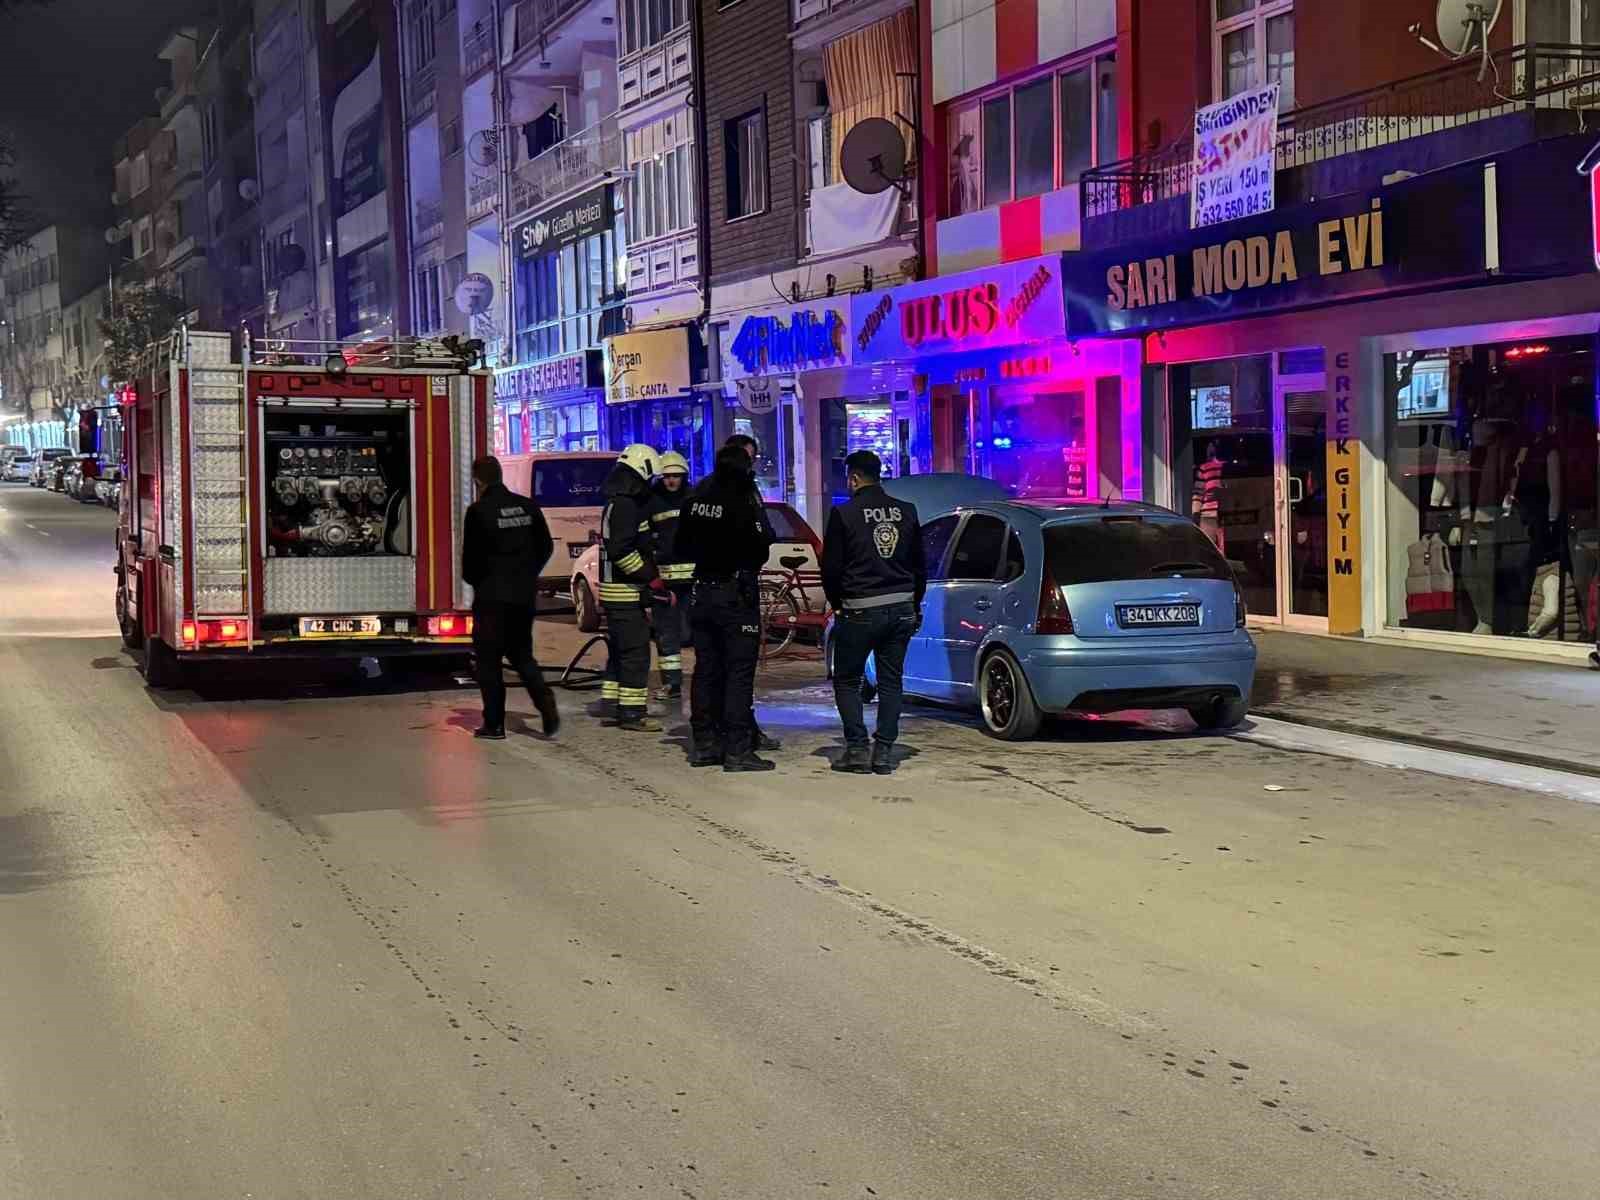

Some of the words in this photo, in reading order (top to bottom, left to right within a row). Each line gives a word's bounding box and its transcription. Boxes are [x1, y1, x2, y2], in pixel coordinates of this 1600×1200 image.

[1203, 202, 1222, 225] 532
[1225, 197, 1244, 219] 550
[1246, 192, 1260, 214] 84
[1106, 254, 1177, 313] SARI
[1192, 230, 1298, 297] MODA
[1318, 197, 1384, 276] EVİ
[898, 282, 999, 348] ULUS
[640, 383, 669, 399] ÇANTA
[1335, 352, 1350, 455] ERKEK
